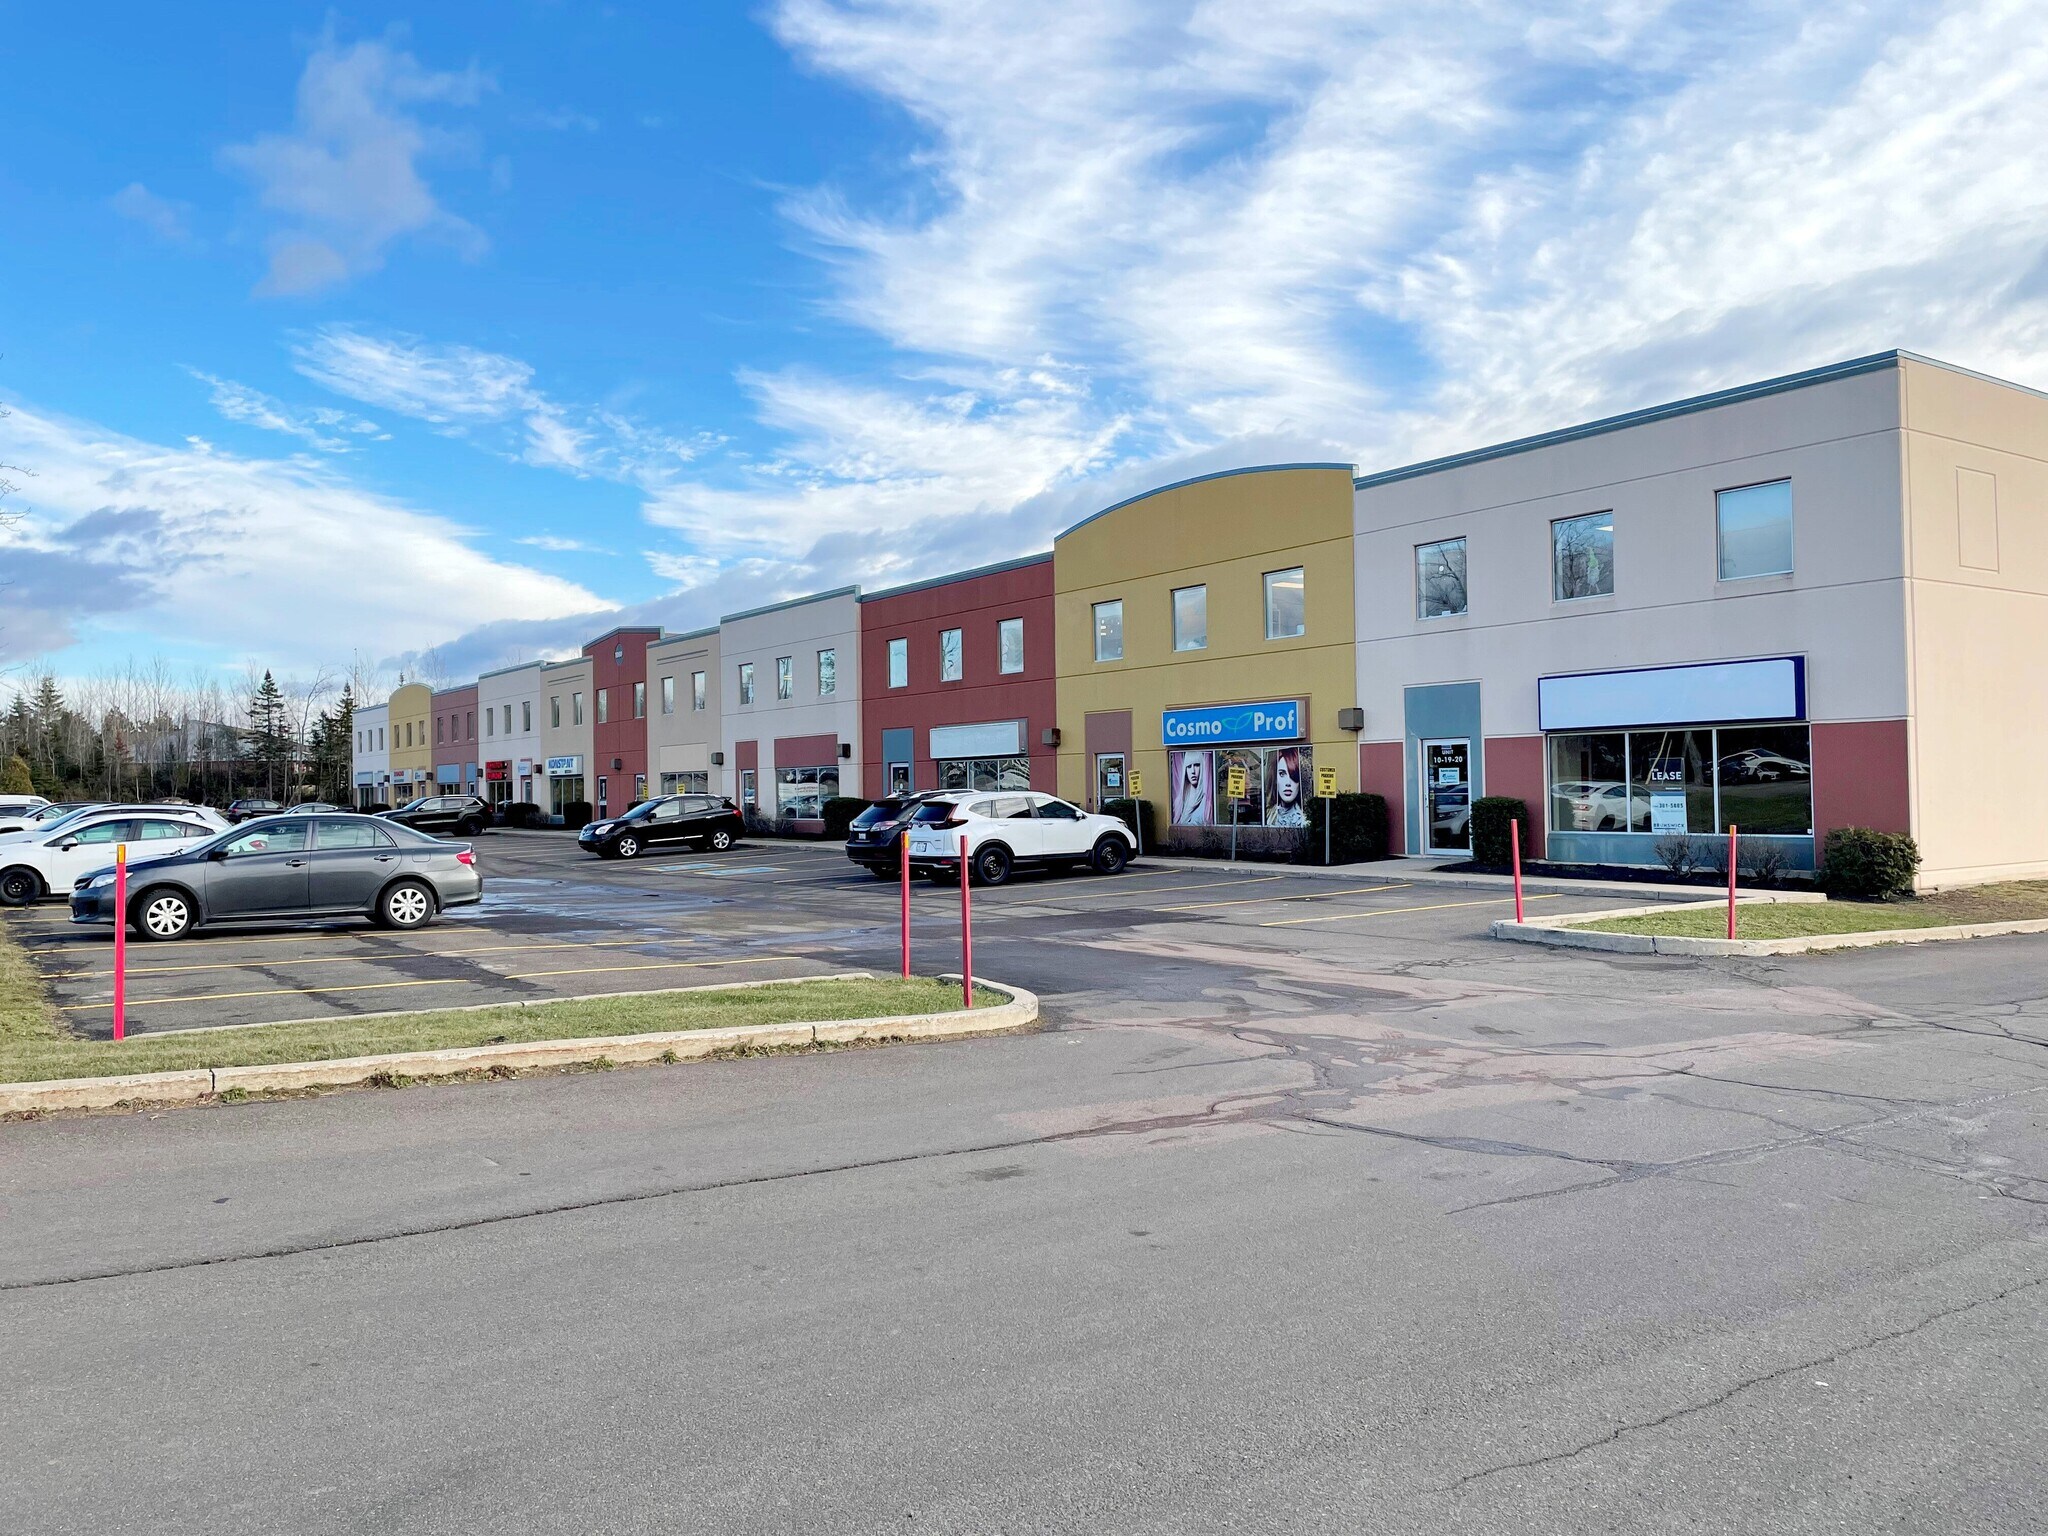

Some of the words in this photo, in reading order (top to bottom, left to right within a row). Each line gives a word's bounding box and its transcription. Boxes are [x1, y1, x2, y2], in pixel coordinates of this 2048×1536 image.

[1166, 717, 1222, 737] Cosmo
[1253, 709, 1295, 732] Prof
[1651, 771, 1682, 780] LEASE
